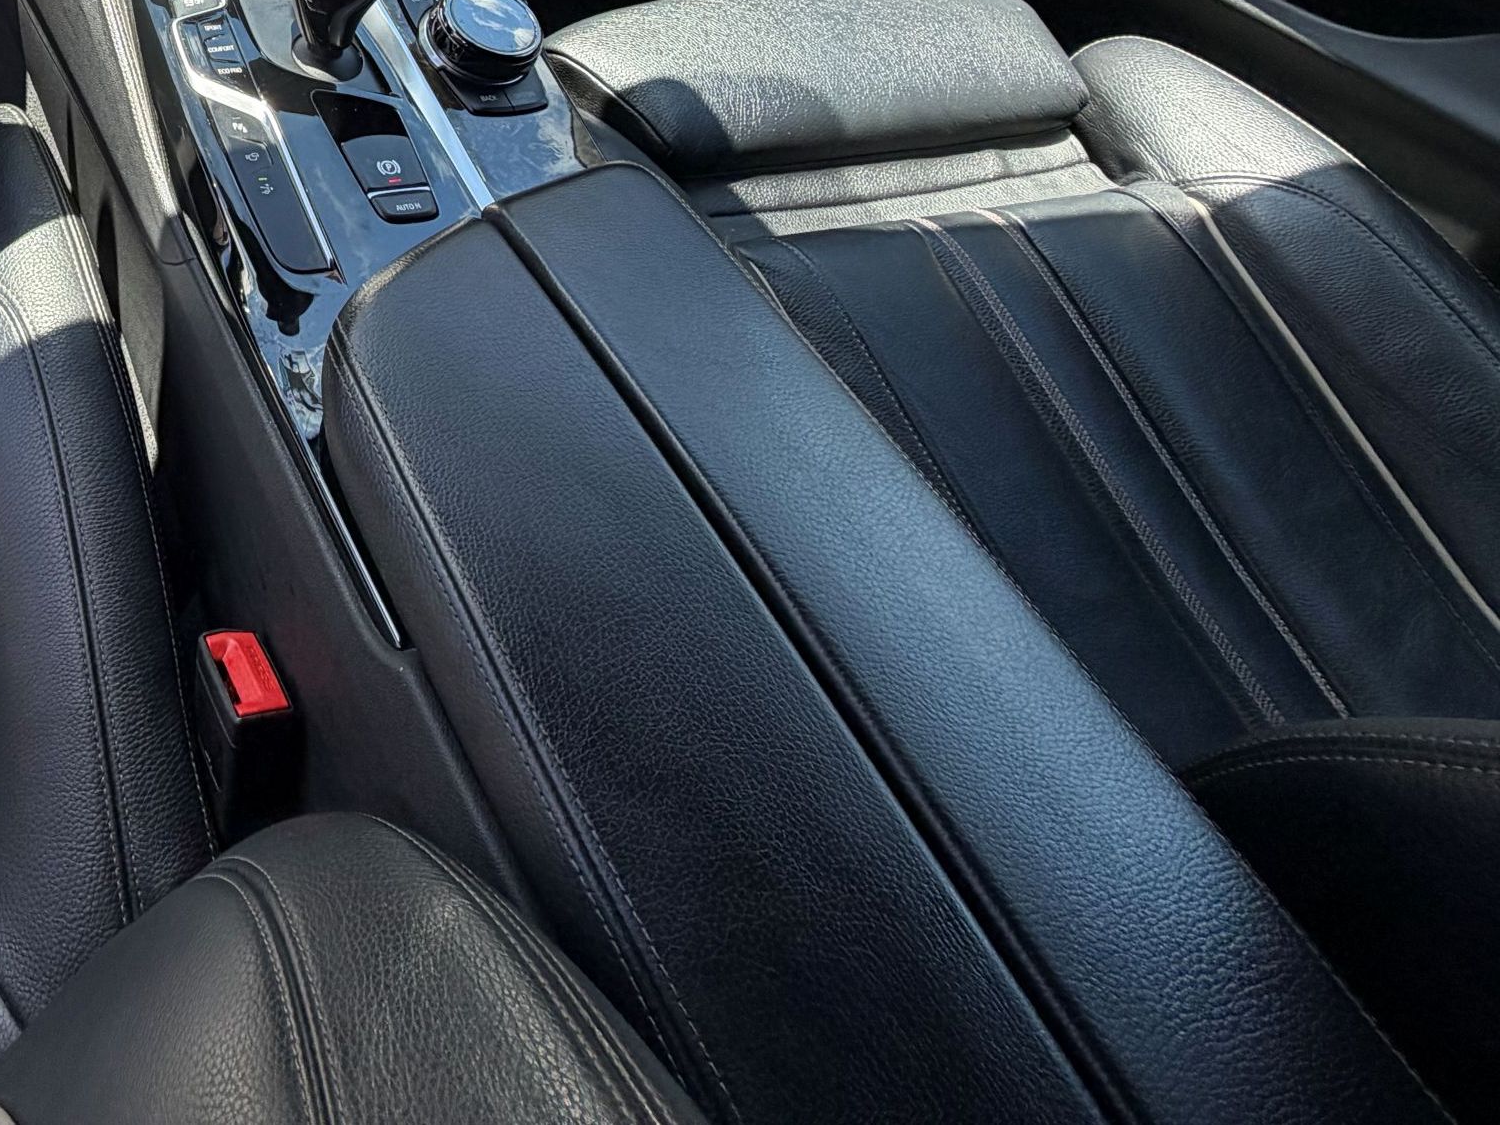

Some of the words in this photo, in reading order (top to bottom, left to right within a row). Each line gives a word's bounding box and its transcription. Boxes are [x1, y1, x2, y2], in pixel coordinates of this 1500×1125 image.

[207, 44, 235, 53] COMFORT
[217, 67, 230, 75] ECO
[396, 203, 415, 212] AUTO
